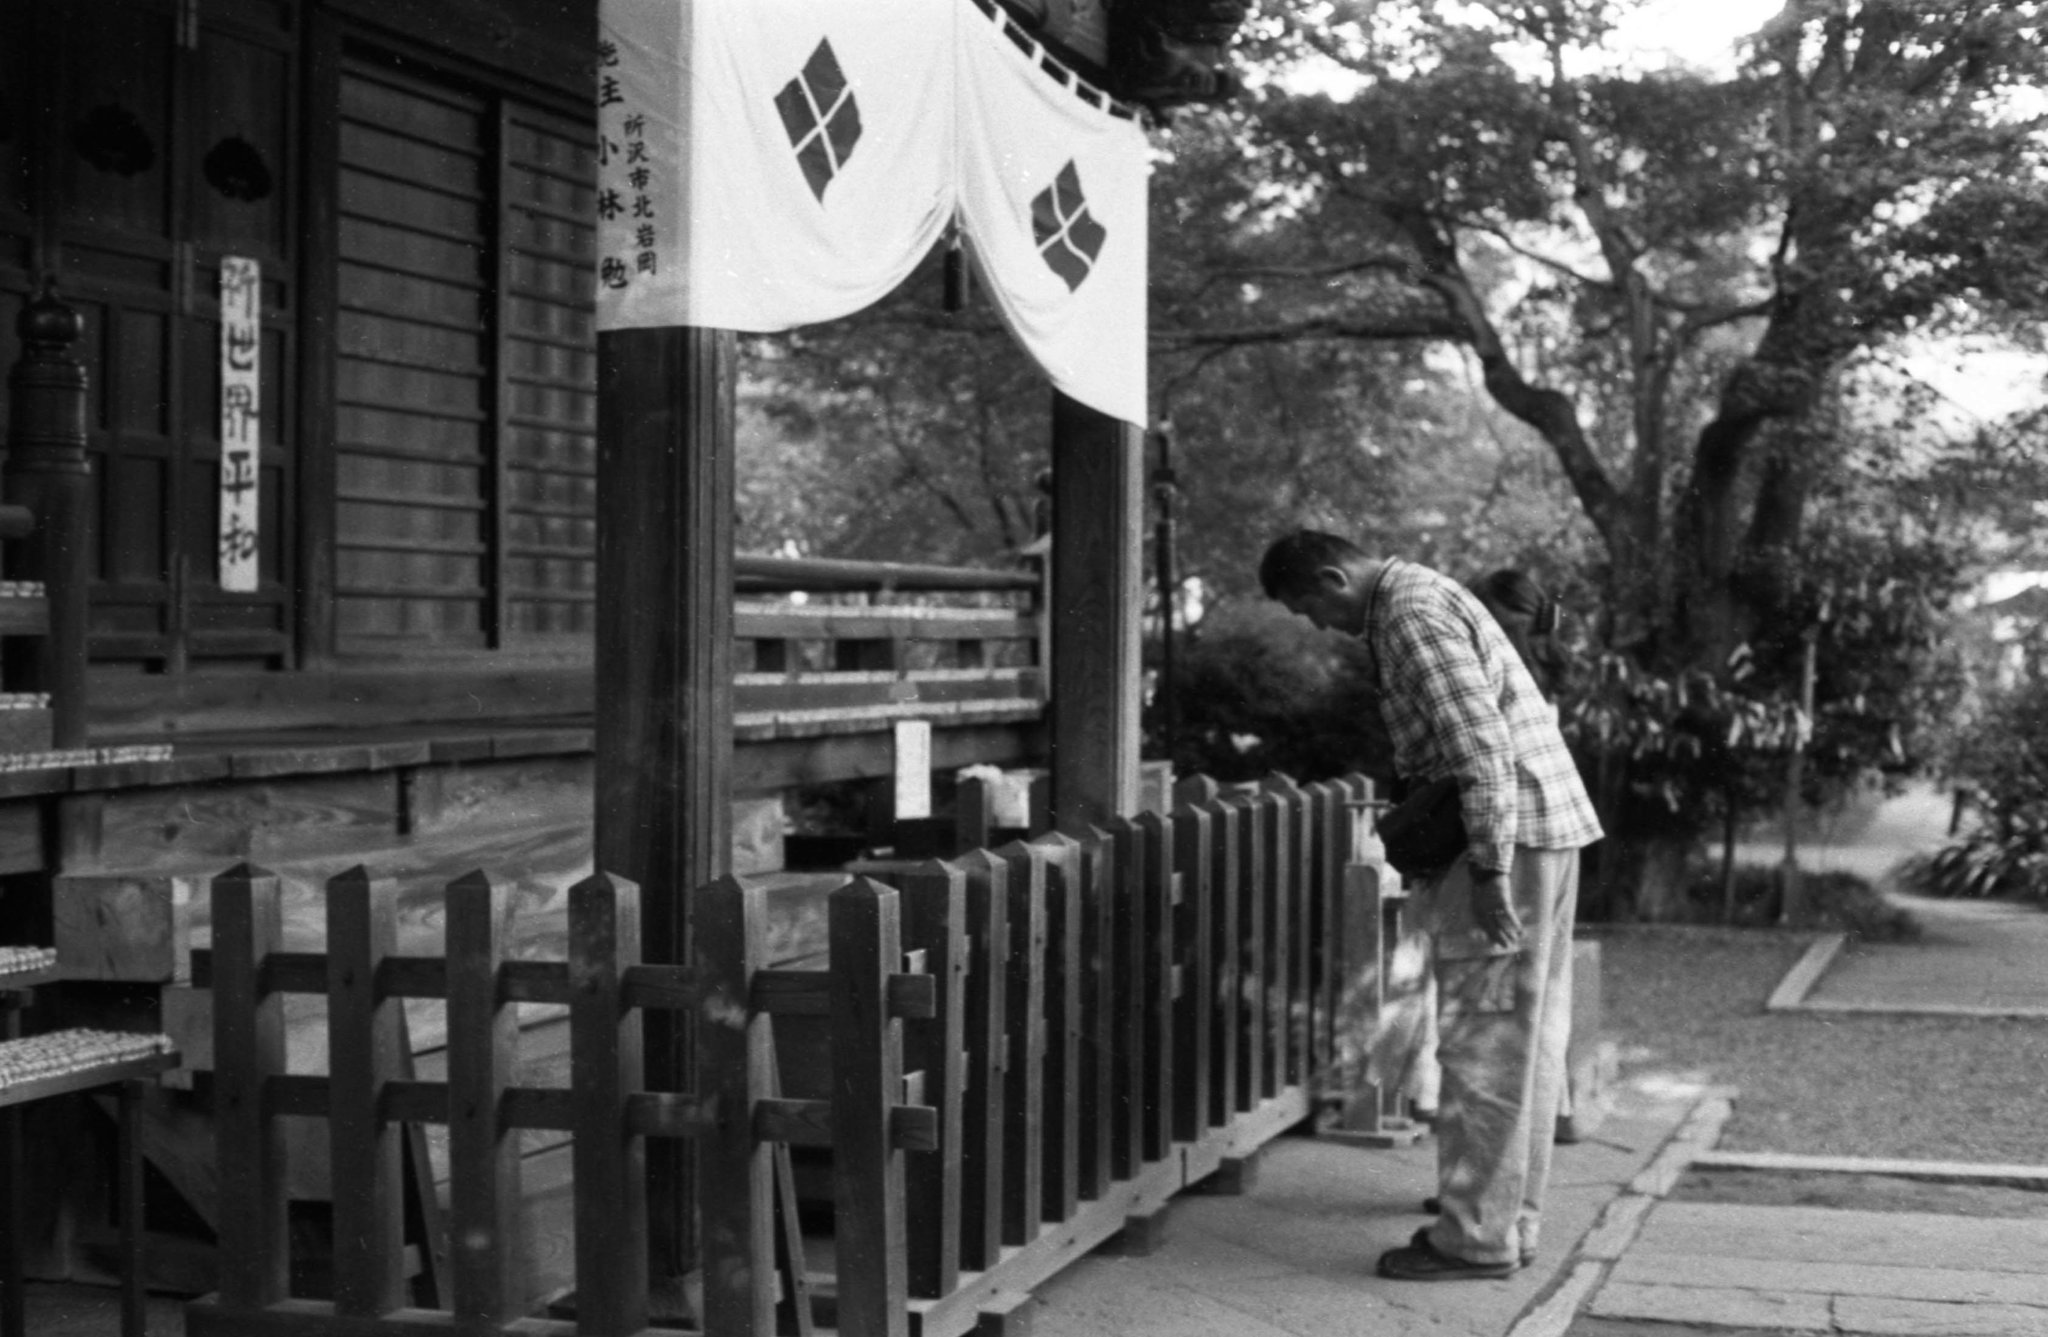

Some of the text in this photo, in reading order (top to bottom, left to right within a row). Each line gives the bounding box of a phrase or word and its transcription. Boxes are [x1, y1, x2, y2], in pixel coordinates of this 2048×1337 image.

[624, 114, 656, 276] 所沢市北岩岡
